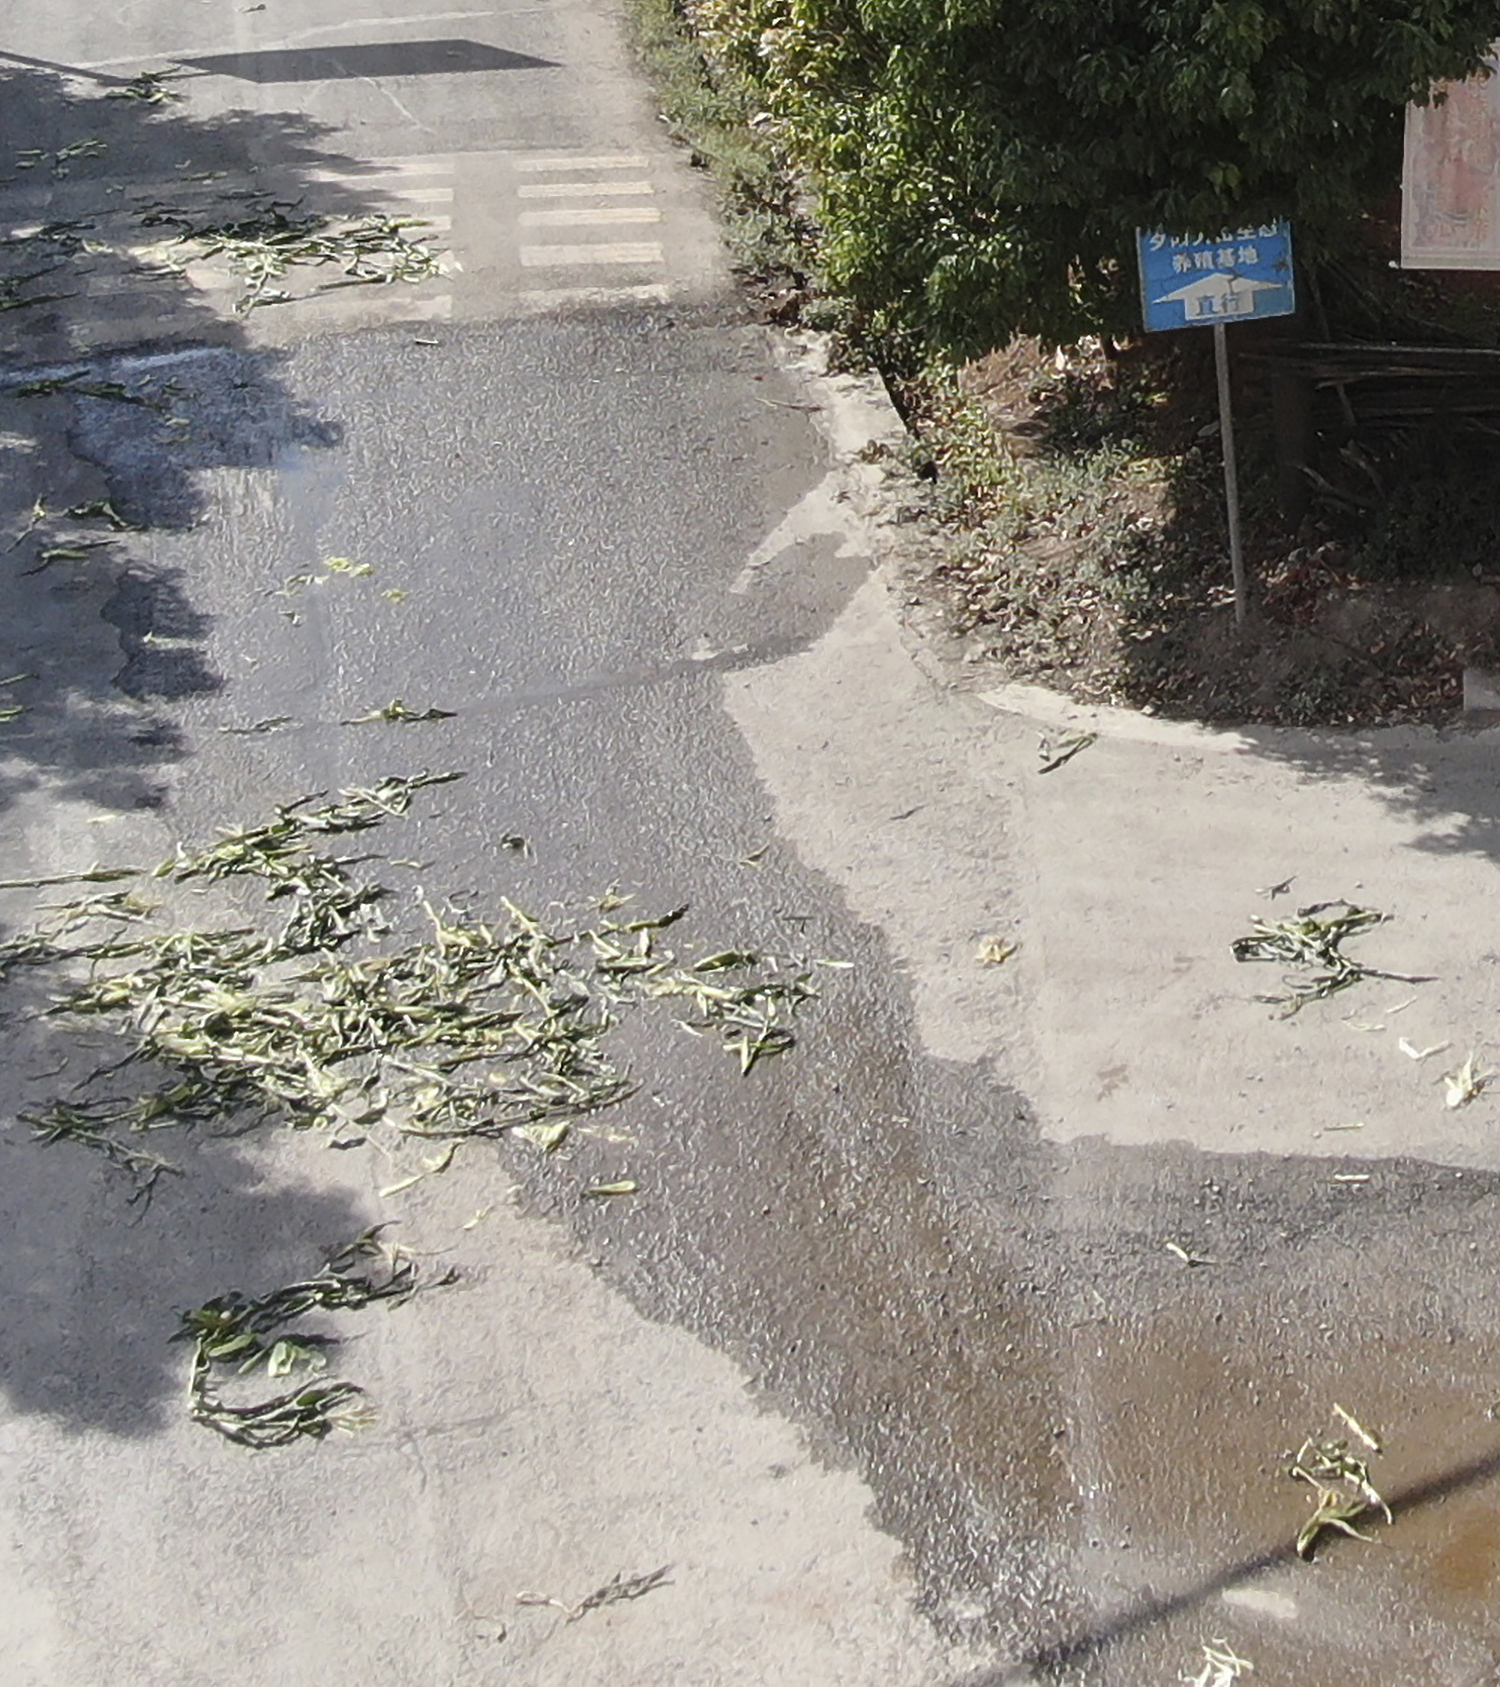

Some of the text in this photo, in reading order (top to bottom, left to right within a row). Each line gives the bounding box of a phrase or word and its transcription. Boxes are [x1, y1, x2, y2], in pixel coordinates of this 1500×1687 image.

[1172, 244, 1259, 273] 养殖基地
[1196, 292, 1239, 316] 直行
